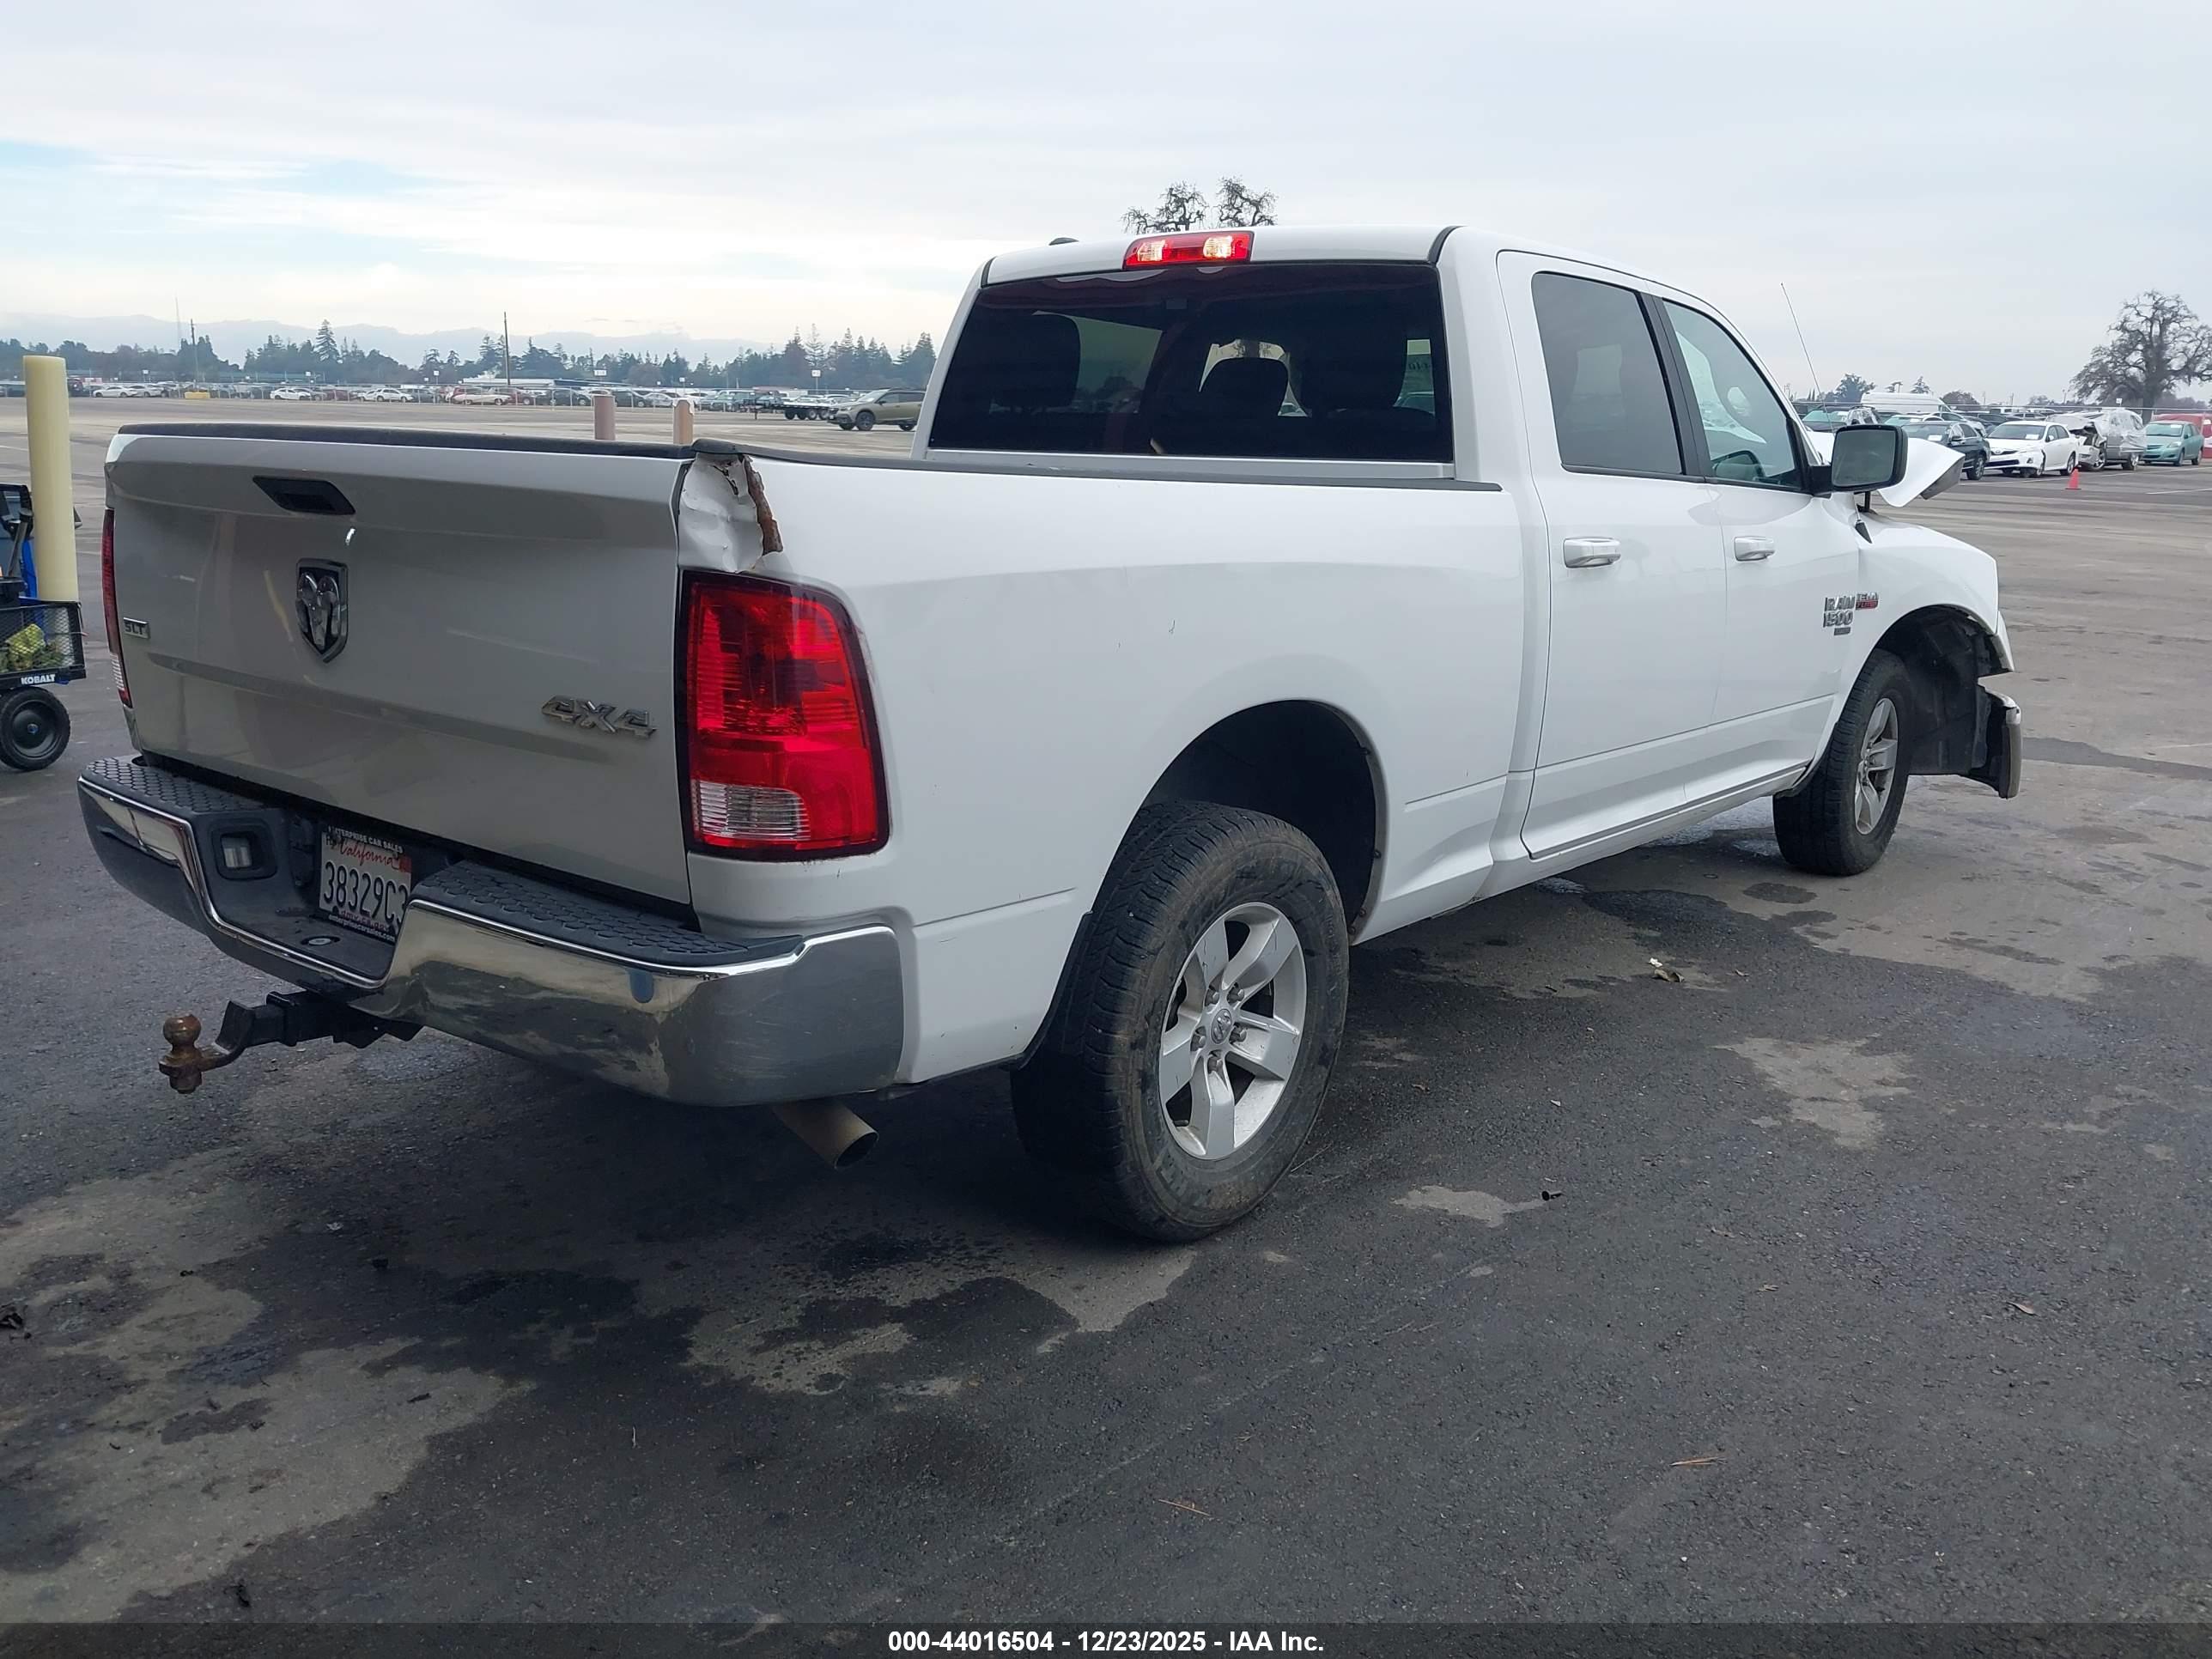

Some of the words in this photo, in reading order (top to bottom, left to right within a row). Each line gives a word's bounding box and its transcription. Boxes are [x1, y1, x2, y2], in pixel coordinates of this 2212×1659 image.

[1825, 596, 1856, 611] RAM
[124, 620, 145, 636] SLT
[21, 673, 56, 685] KOBALT
[328, 825, 368, 844] TERPRISE
[368, 836, 382, 848] CAR
[383, 841, 404, 854] SALES
[339, 838, 394, 866] California
